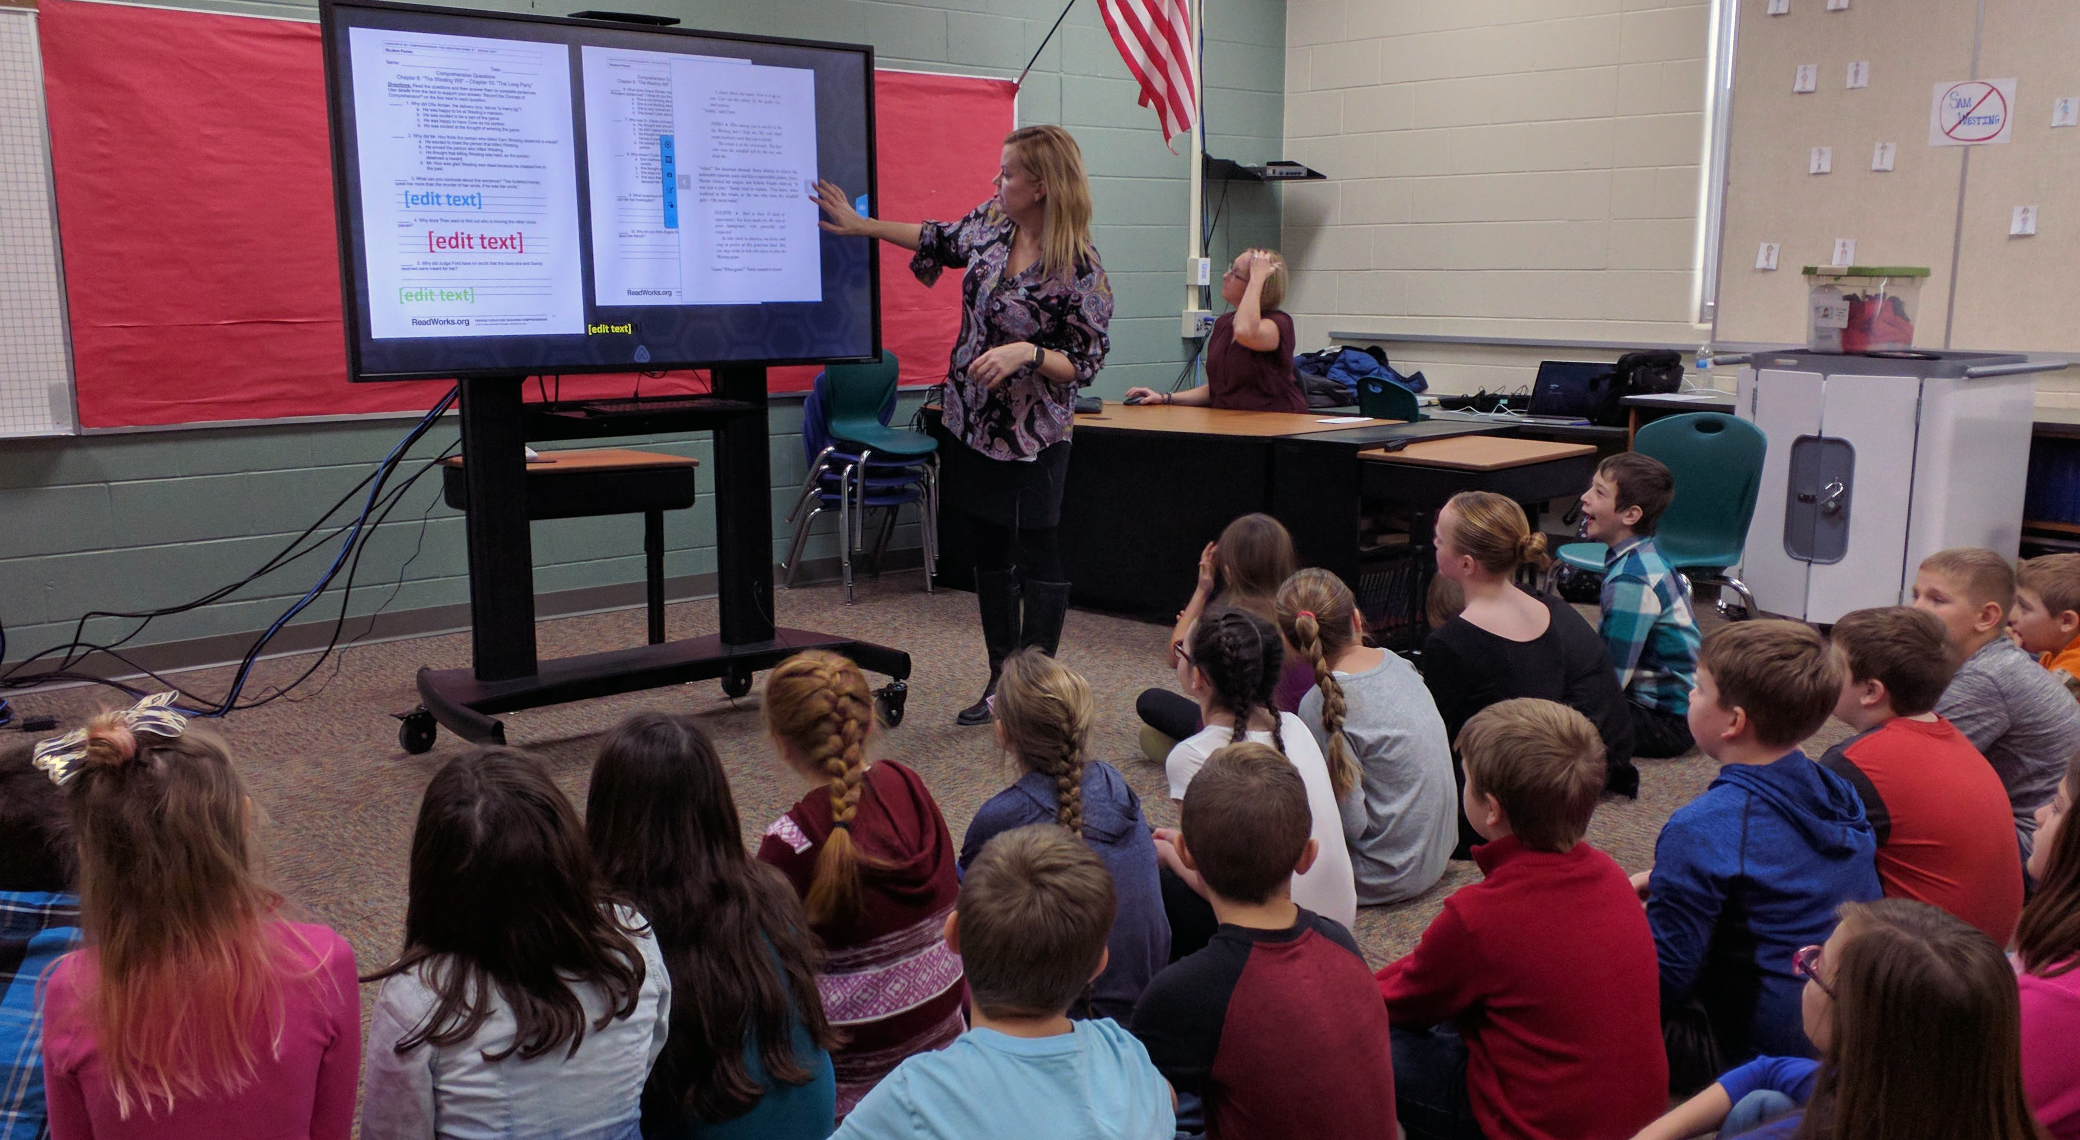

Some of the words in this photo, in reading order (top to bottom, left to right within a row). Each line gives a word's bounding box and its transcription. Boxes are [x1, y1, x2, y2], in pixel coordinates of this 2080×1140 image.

[1949, 91, 1972, 109] SAM
[1958, 112, 2000, 126] WESTING
[405, 191, 441, 209] [edit
[445, 192, 482, 210] text]
[428, 230, 474, 253] [edit
[479, 231, 523, 253] text]
[399, 287, 435, 304] [edit
[439, 287, 474, 304] text]
[411, 318, 470, 327] ReadWorks.org
[588, 324, 609, 335] [edit
[611, 324, 631, 335] text]
